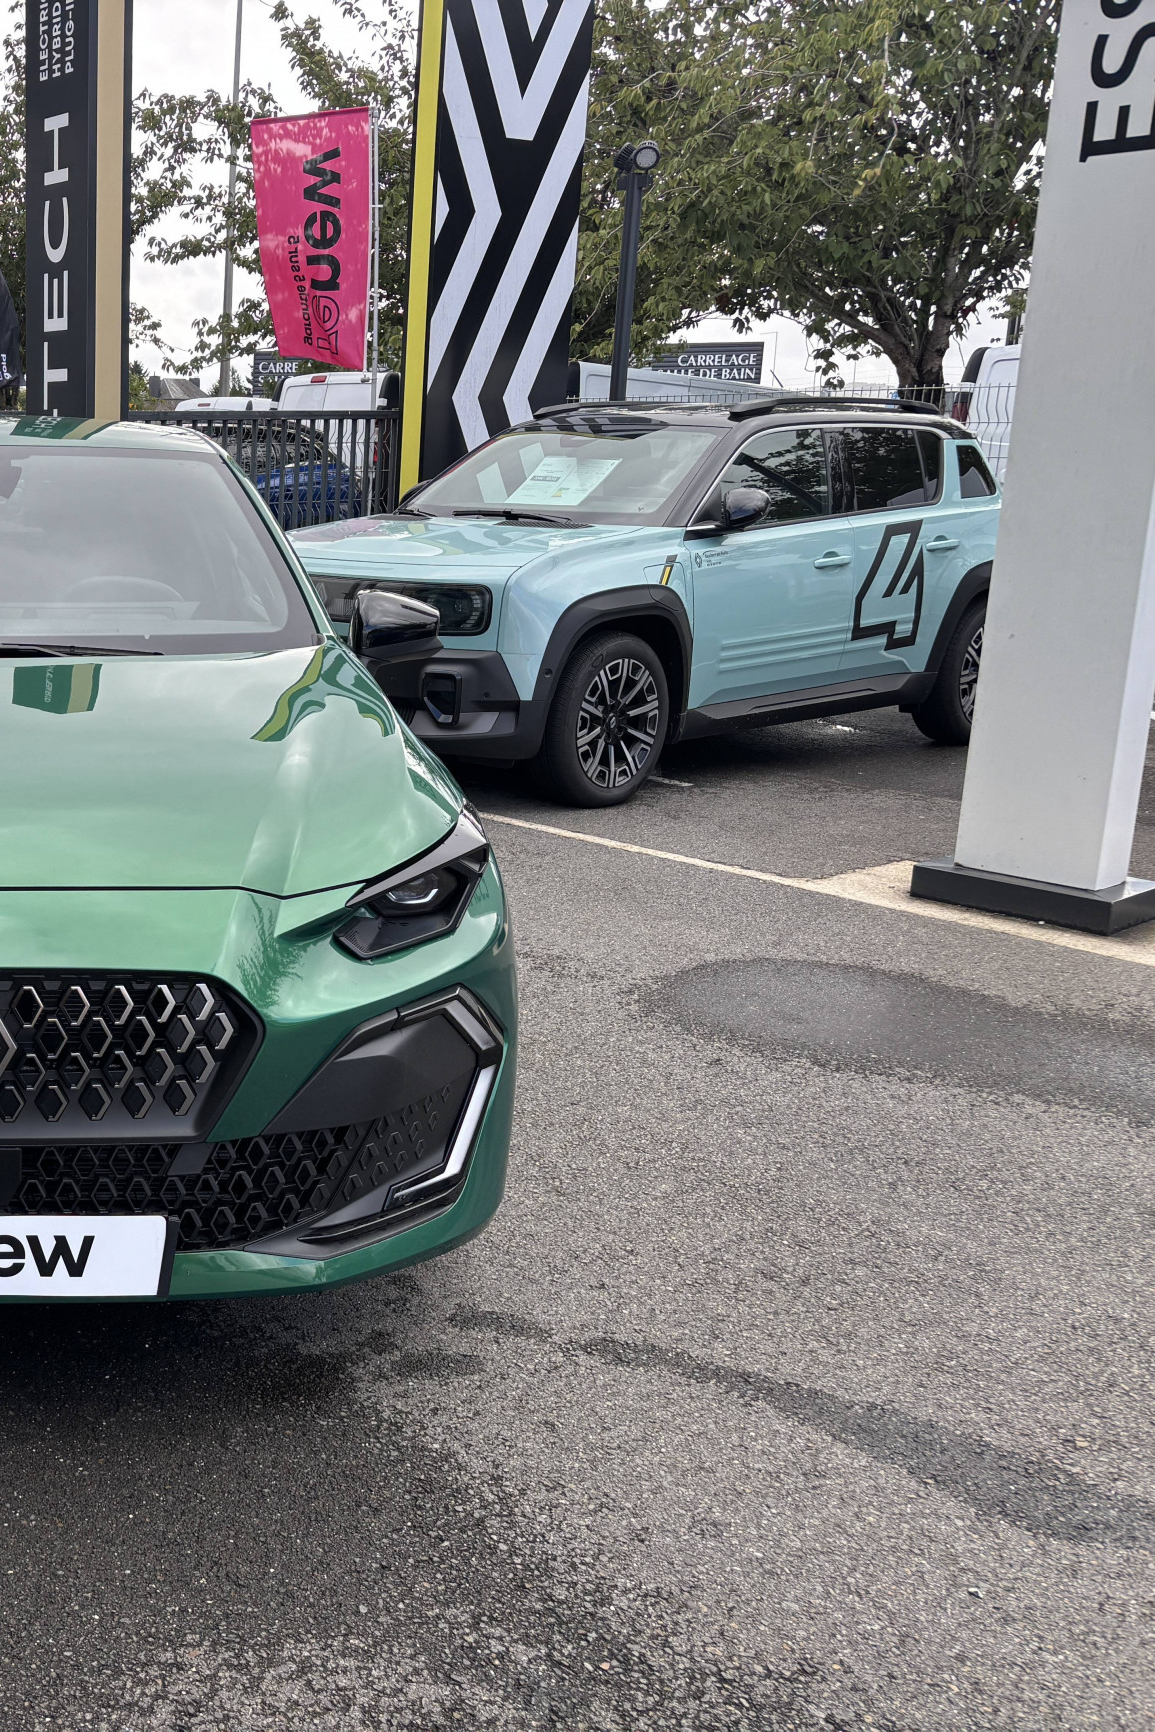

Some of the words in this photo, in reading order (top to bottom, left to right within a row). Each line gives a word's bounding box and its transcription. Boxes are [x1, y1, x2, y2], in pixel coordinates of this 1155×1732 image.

[39, 0, 49, 82] ELECTRI
[52, 1, 62, 78] HYBRID
[65, 0, 75, 74] PLUG-I
[1079, 0, 1155, 163] ES
[43, 112, 70, 416] TECH
[1, 354, 12, 380] gold
[677, 353, 757, 367] CARRELAGE
[721, 368, 756, 380] BAIN
